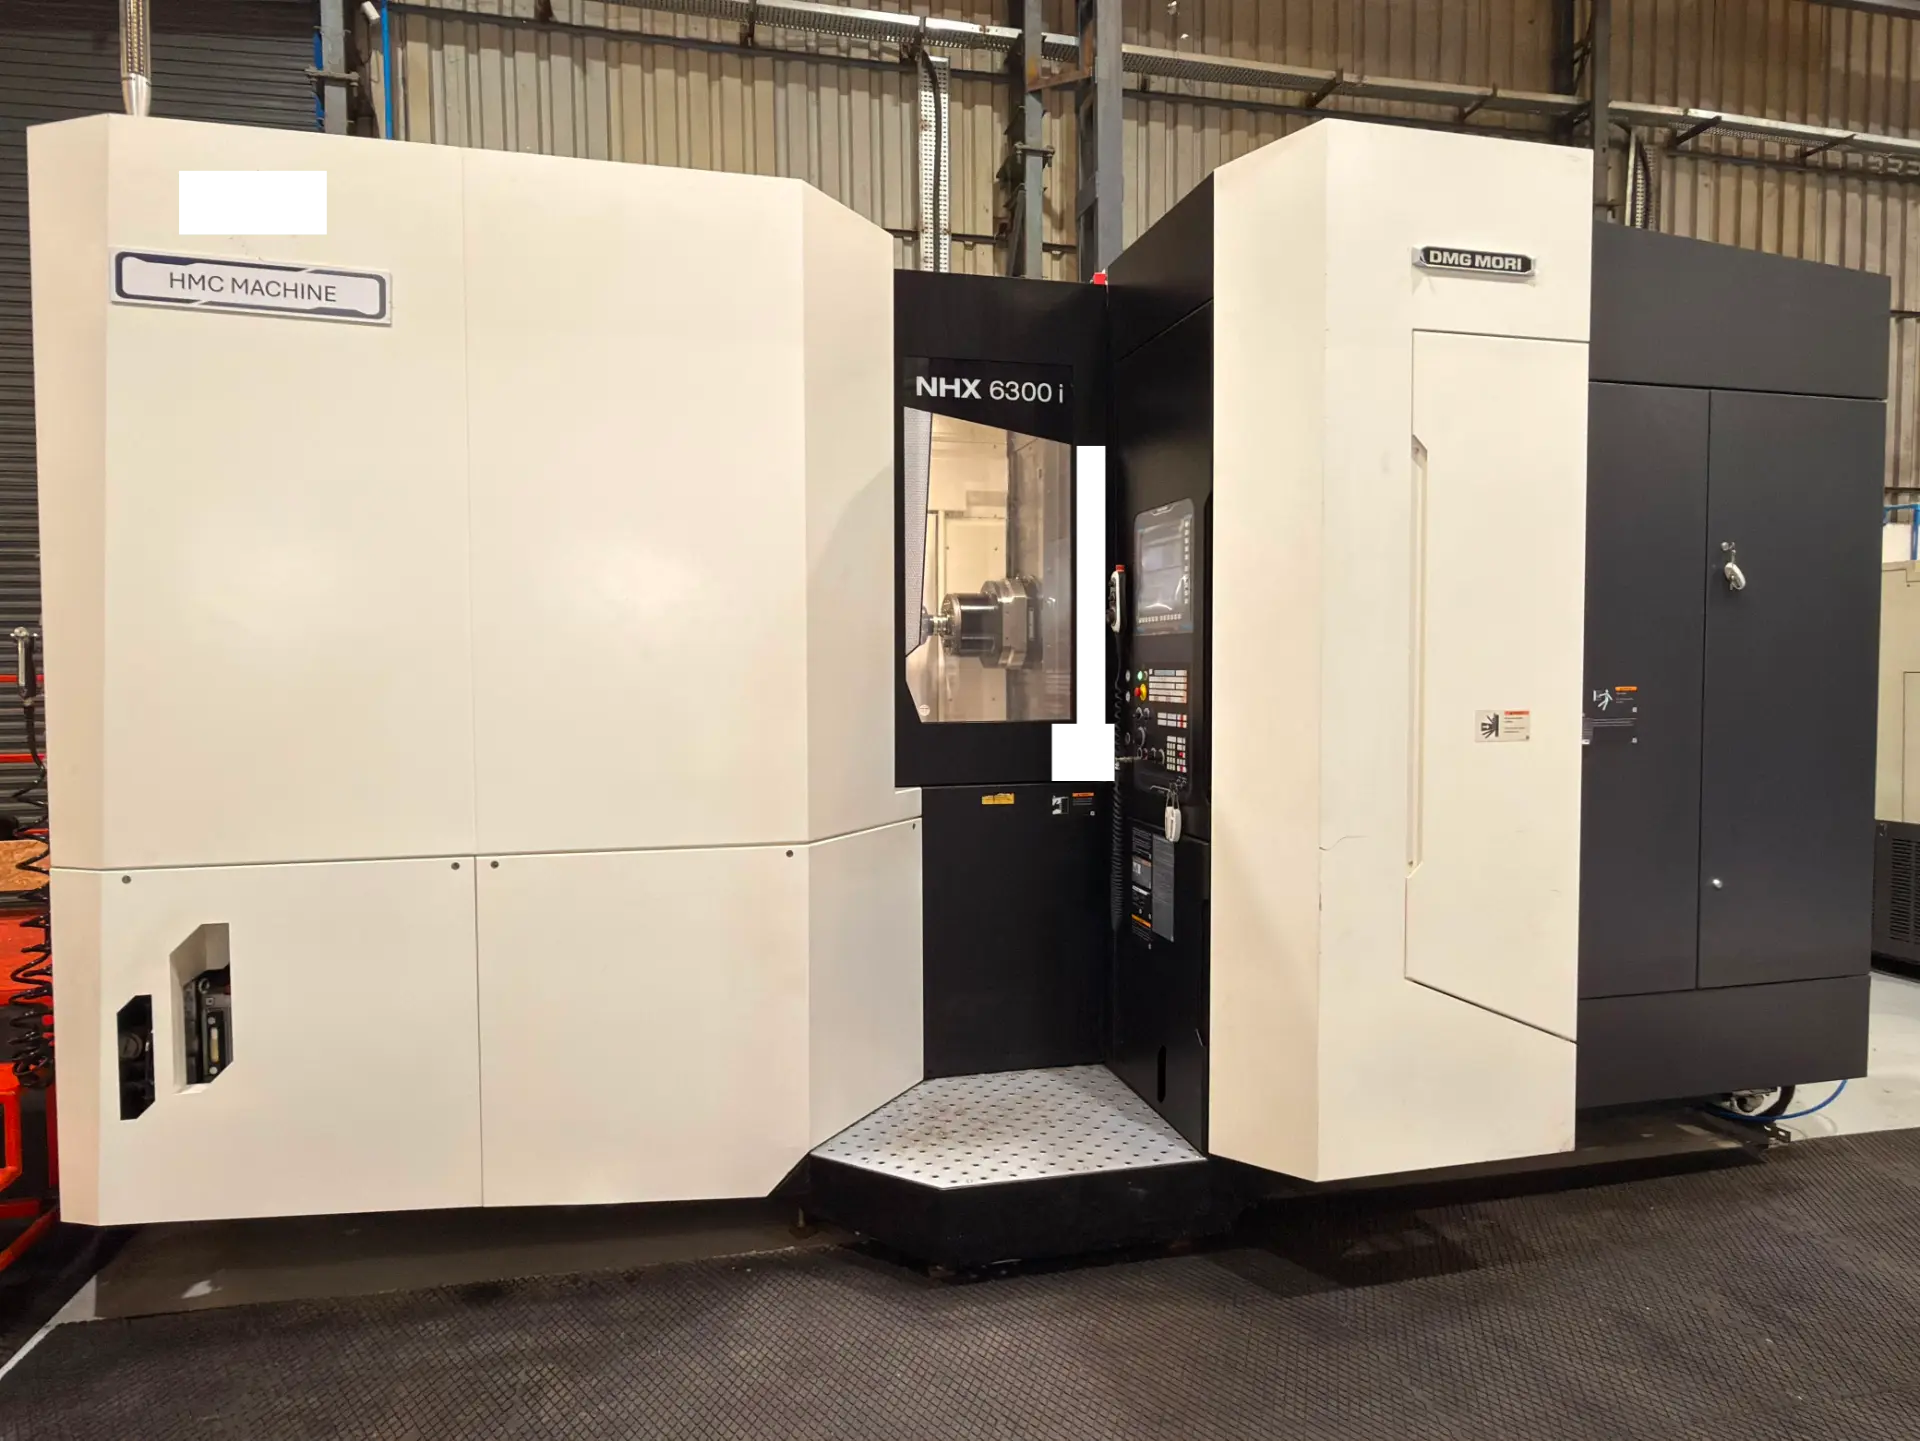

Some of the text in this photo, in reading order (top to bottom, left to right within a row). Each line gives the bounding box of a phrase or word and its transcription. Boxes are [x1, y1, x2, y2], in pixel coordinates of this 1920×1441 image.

[1429, 250, 1522, 271] DMG MORI
[169, 271, 337, 302] HMC MACHINE
[916, 375, 982, 399] NHX
